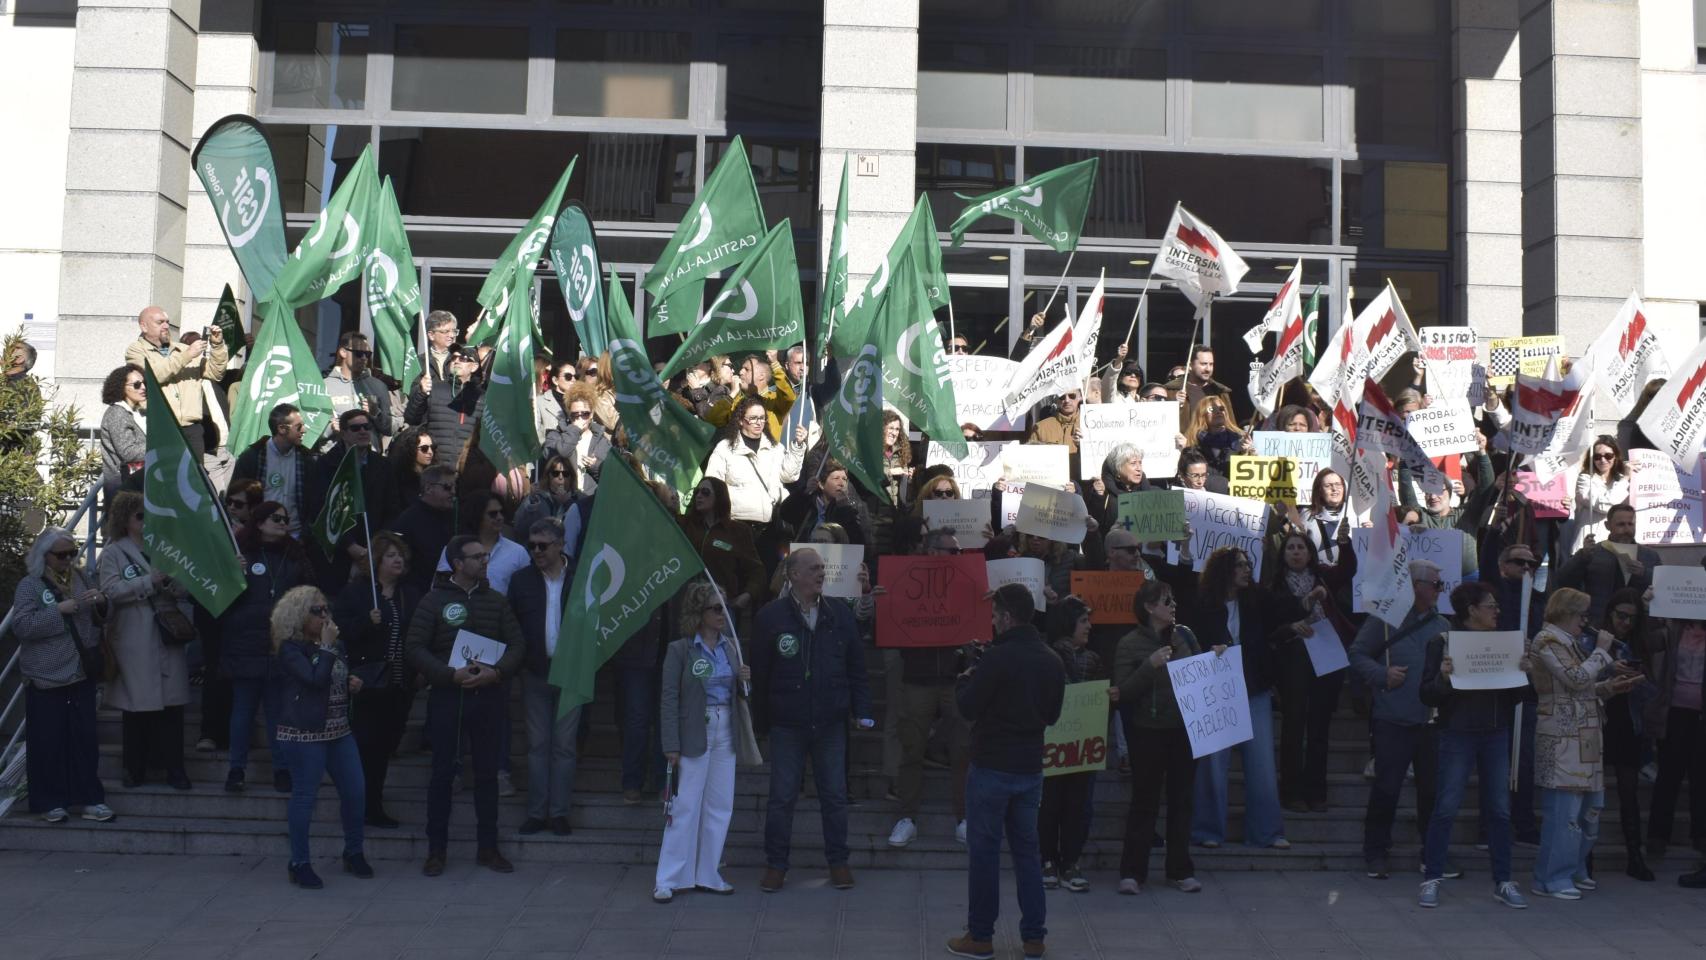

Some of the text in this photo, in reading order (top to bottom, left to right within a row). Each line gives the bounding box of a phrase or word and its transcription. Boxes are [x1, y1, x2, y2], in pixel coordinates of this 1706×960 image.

[1418, 434, 1478, 449] ESTERRADO
[1424, 423, 1455, 435] NO ES
[1235, 460, 1296, 481] STOP
[1232, 485, 1298, 499] RECORTES
[905, 566, 955, 601] STOP
[1173, 656, 1232, 689] NUESTRA VIDA
[1180, 678, 1236, 713] NO ES SU
[1188, 706, 1240, 743] TABLERO
